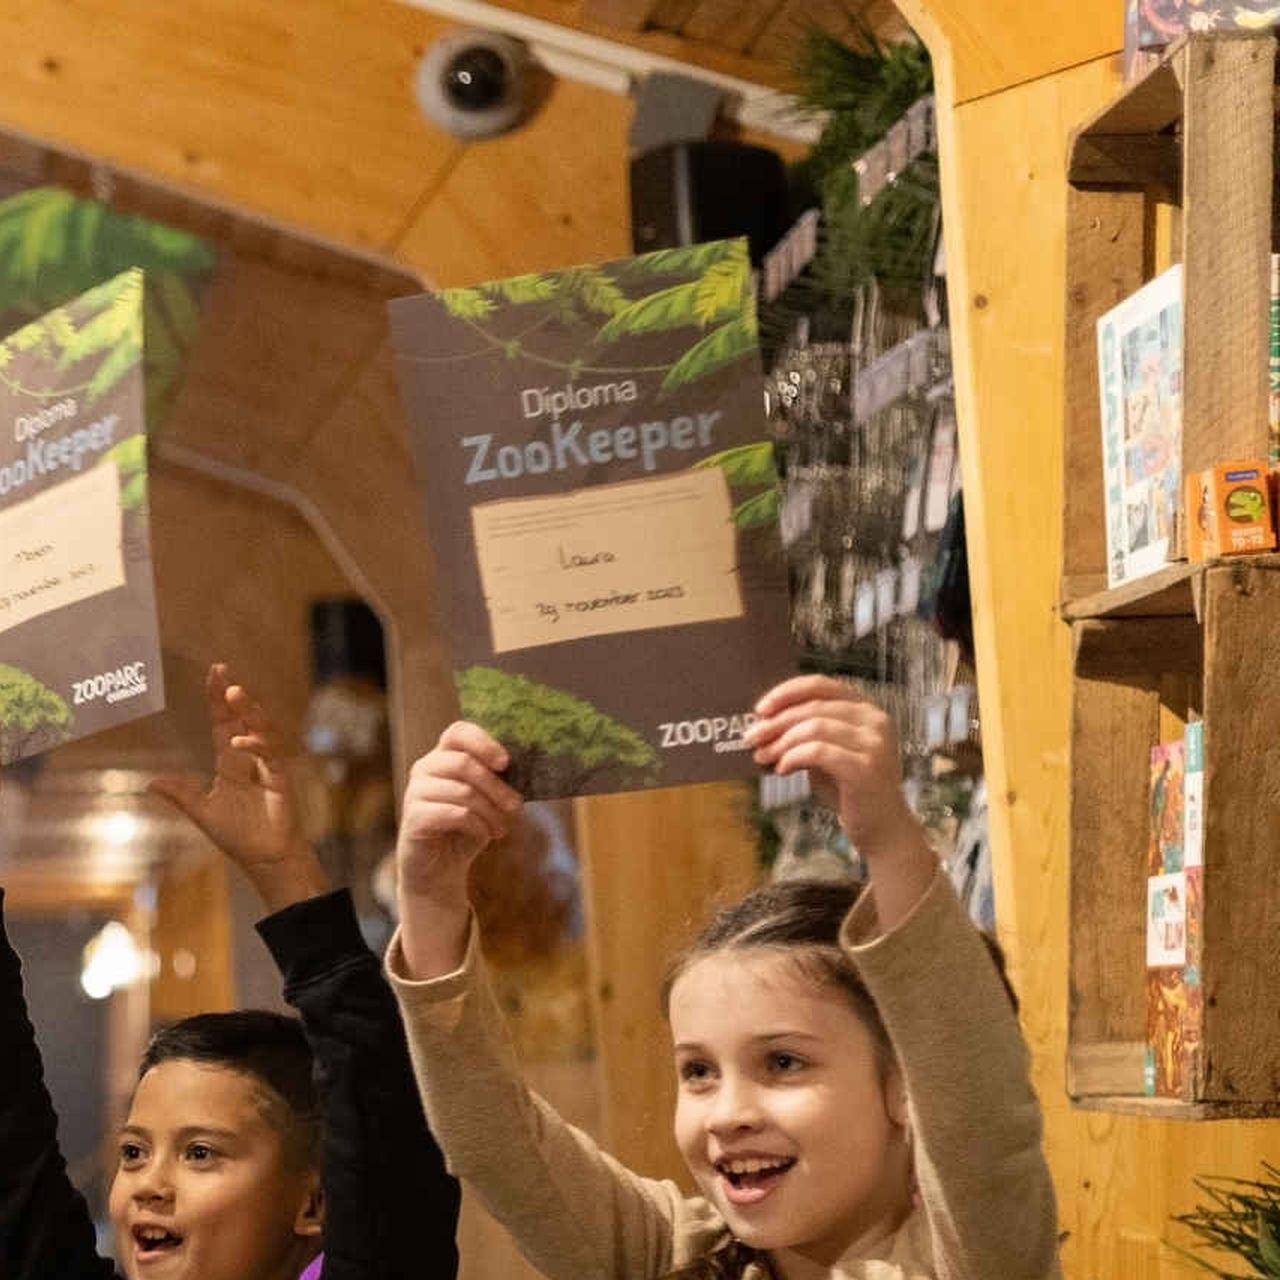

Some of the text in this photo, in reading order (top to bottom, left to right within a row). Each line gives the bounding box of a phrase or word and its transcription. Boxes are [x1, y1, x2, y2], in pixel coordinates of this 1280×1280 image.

[14, 398, 78, 444] Diploma
[520, 378, 638, 425] Diploma
[461, 409, 722, 486] ZooKeeper
[564, 589, 640, 613] november
[71, 661, 147, 705] ZOOPARC
